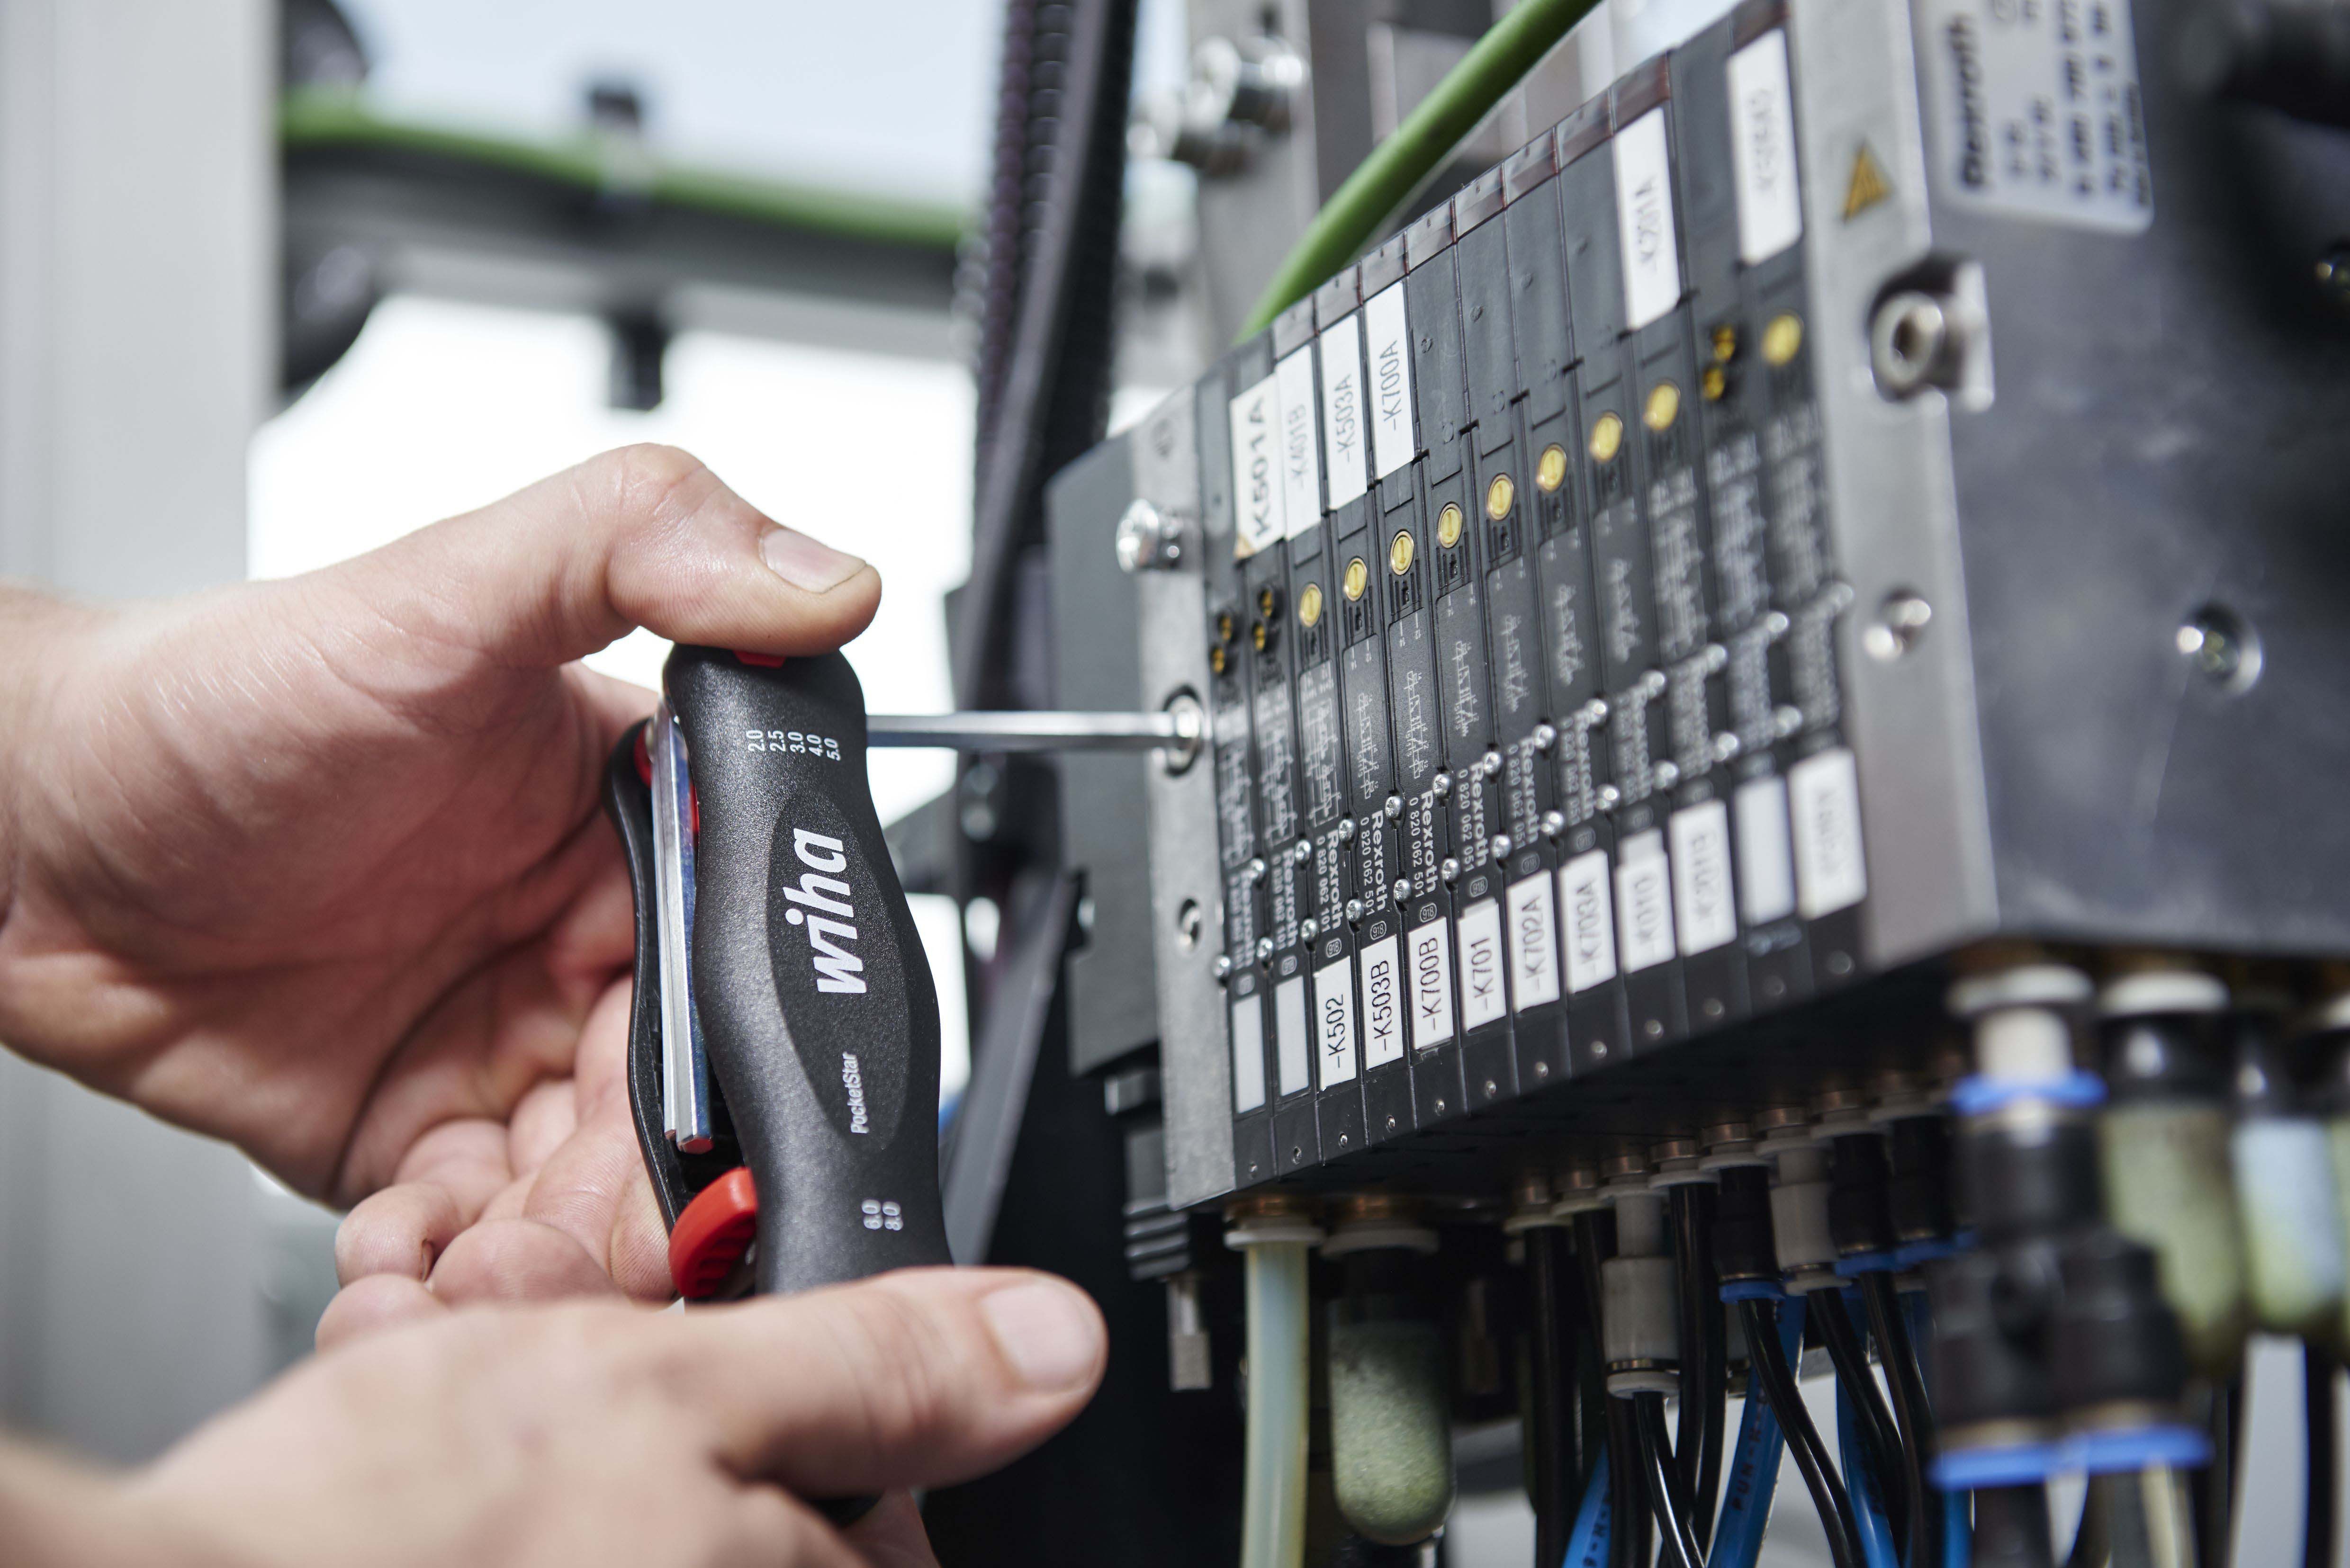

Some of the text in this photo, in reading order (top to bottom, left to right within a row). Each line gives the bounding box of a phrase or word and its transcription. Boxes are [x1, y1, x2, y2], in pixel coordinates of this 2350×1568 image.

[1334, 374, 1355, 462] -K503A
[1380, 340, 1402, 430] -K700A
[1247, 398, 1270, 537] K501A
[746, 730, 765, 752] 2.0
[767, 730, 786, 752] 2.5
[787, 732, 806, 753] 3.0
[806, 734, 824, 756] 4.0
[824, 738, 841, 761] 5.0
[1576, 709, 1595, 821] Rexroth
[1458, 770, 1474, 872] 0 820 062 051
[1469, 762, 1488, 867] Rexroth
[1507, 744, 1525, 850] 0 820 062 051
[1520, 737, 1540, 844] Rexroth
[1316, 836, 1331, 933] 0 820 062 101
[1327, 829, 1343, 930] Rexroth
[1360, 817, 1376, 916] 0 820 062 501
[1371, 810, 1388, 911] Rexroth
[1409, 797, 1425, 898] 0 820 062 501
[1420, 790, 1438, 893] Rexroth
[1473, 879, 1485, 893] 918
[786, 828, 866, 995] wiha
[1281, 848, 1298, 947] Rexroth
[1373, 923, 1384, 936] 918
[1423, 906, 1434, 917] 918
[1522, 894, 1546, 992] -K702A
[1575, 878, 1599, 977] -K703A
[1328, 941, 1339, 953] 918
[1419, 937, 1441, 1030] -K700B
[1470, 936, 1494, 1010] -K701
[1325, 994, 1345, 1068] -K502
[1371, 960, 1393, 1051] -K503B
[843, 1051, 868, 1135] PocketStar
[861, 1199, 882, 1230] 6.0
[883, 1201, 903, 1231] 8.0
